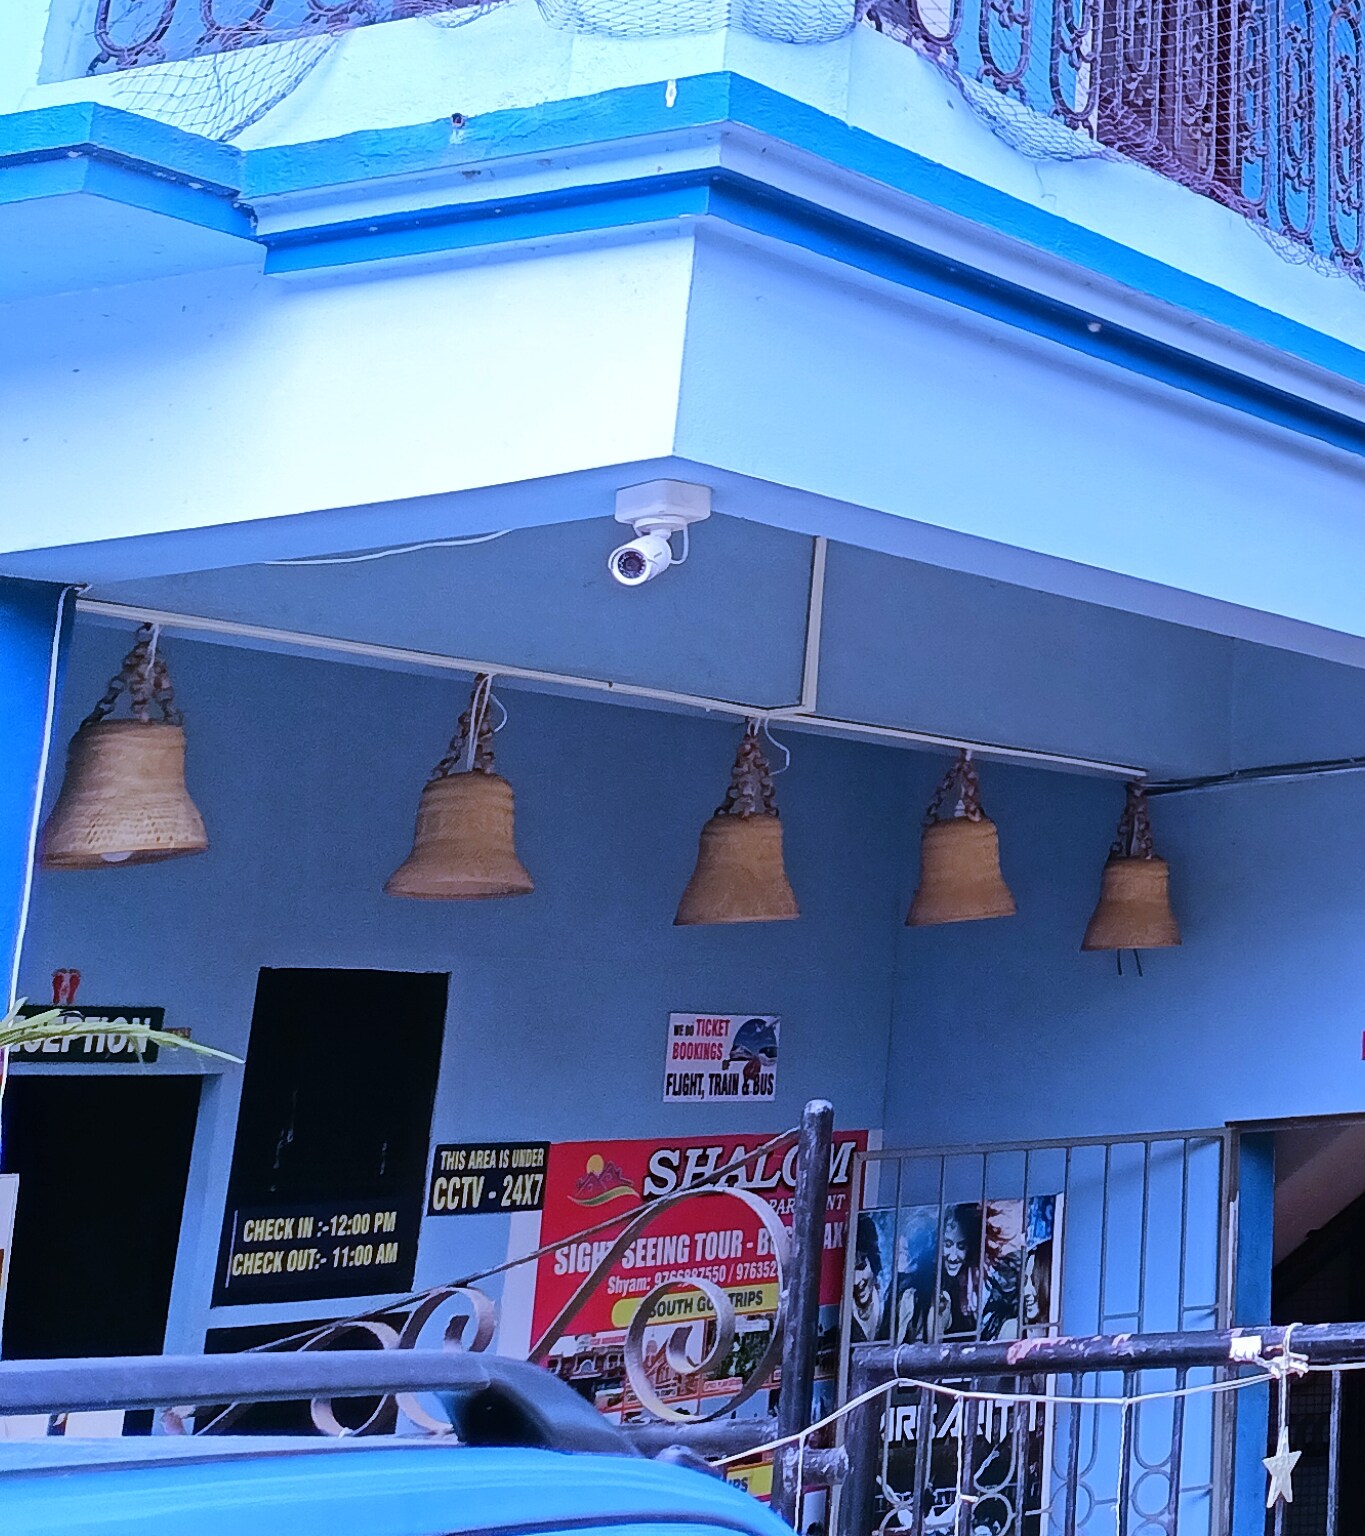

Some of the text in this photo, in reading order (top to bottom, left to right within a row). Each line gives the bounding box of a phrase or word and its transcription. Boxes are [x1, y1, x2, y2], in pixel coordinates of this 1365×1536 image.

[695, 1018, 731, 1037] TICKET
[672, 1041, 724, 1061] BOOKINGS
[665, 1072, 705, 1100] FLIGHT,
[708, 1072, 740, 1096] TRAIN
[752, 1072, 775, 1096] BUS
[440, 1148, 545, 1171] THIS AREA IS UNDER
[432, 1175, 486, 1211] CCTV
[500, 1173, 544, 1207] 24X7
[243, 1217, 294, 1243] CHECK
[297, 1216, 314, 1239] IN
[373, 1211, 397, 1234] PM
[231, 1250, 283, 1277] CHECK
[332, 1244, 373, 1268] 11:00
[375, 1242, 399, 1265] AM
[621, 1233, 690, 1270] SEEING
[694, 1229, 742, 1263] TOUR
[607, 1275, 651, 1298] Shyam:
[727, 1290, 764, 1308] TRIPS
